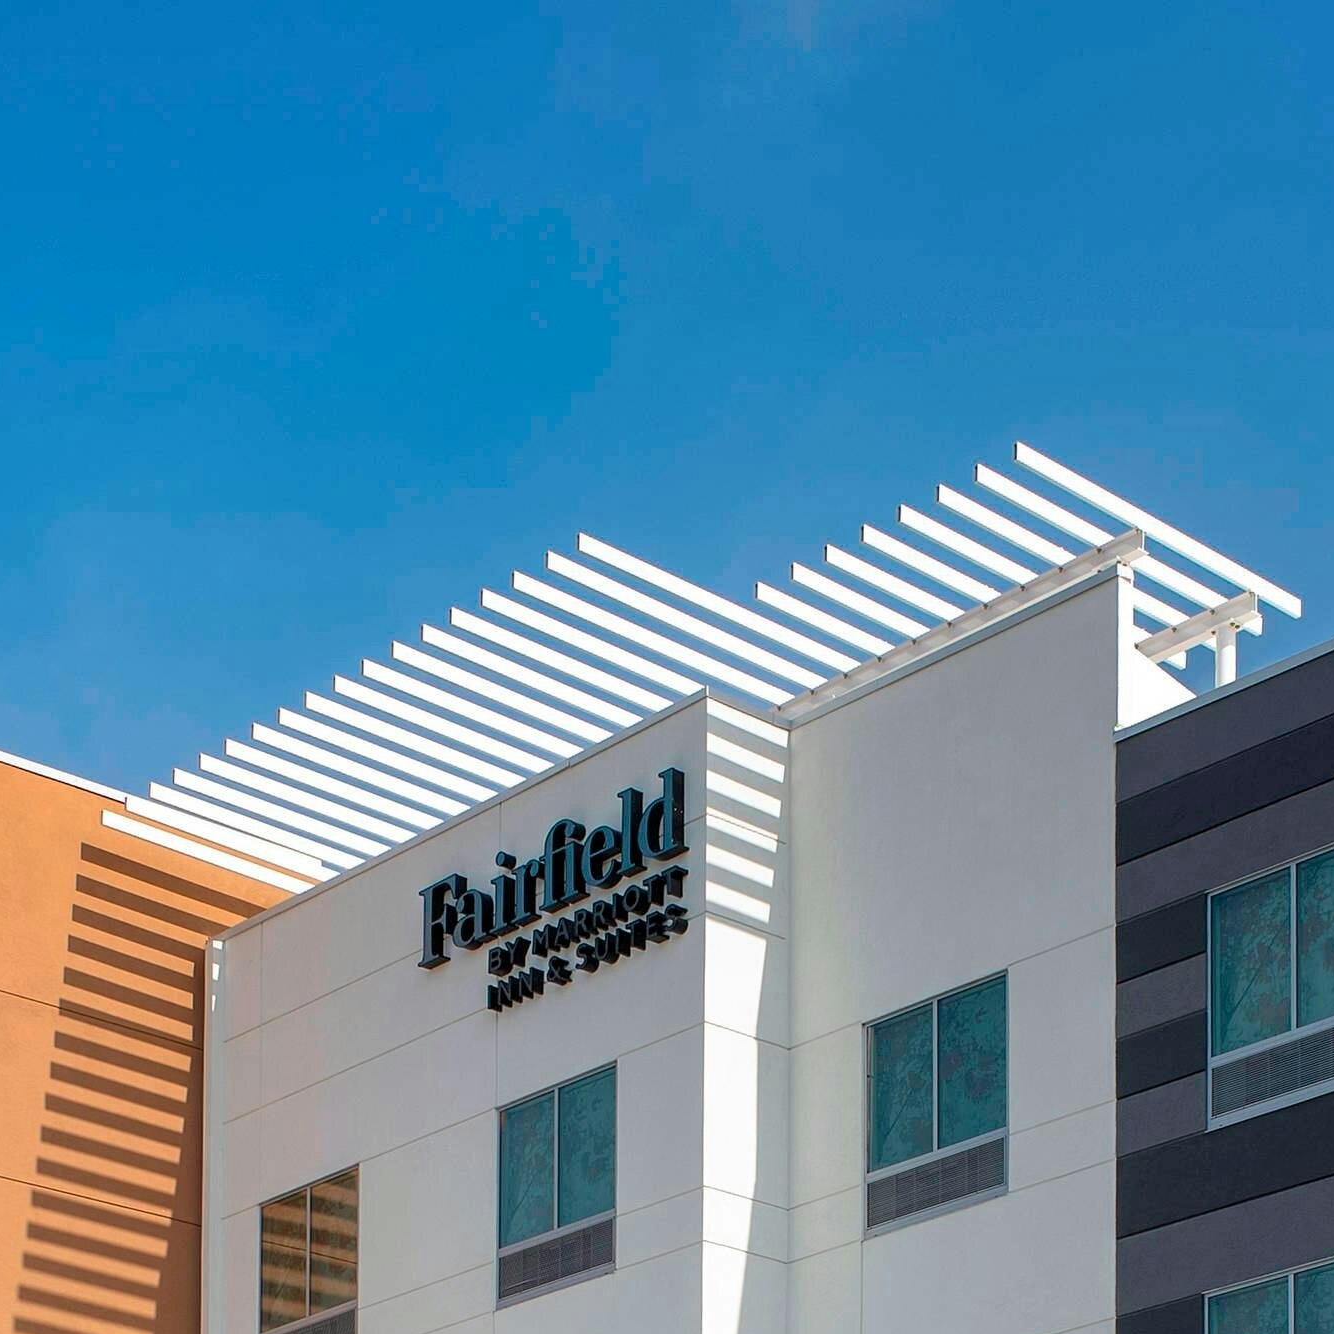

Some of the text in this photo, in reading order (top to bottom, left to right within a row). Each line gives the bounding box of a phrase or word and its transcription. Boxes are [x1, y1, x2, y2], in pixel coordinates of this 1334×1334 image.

[418, 767, 689, 970] Fairfield
[488, 865, 689, 976] BY MARRIOTT
[487, 903, 689, 1012] INN & SUITES
